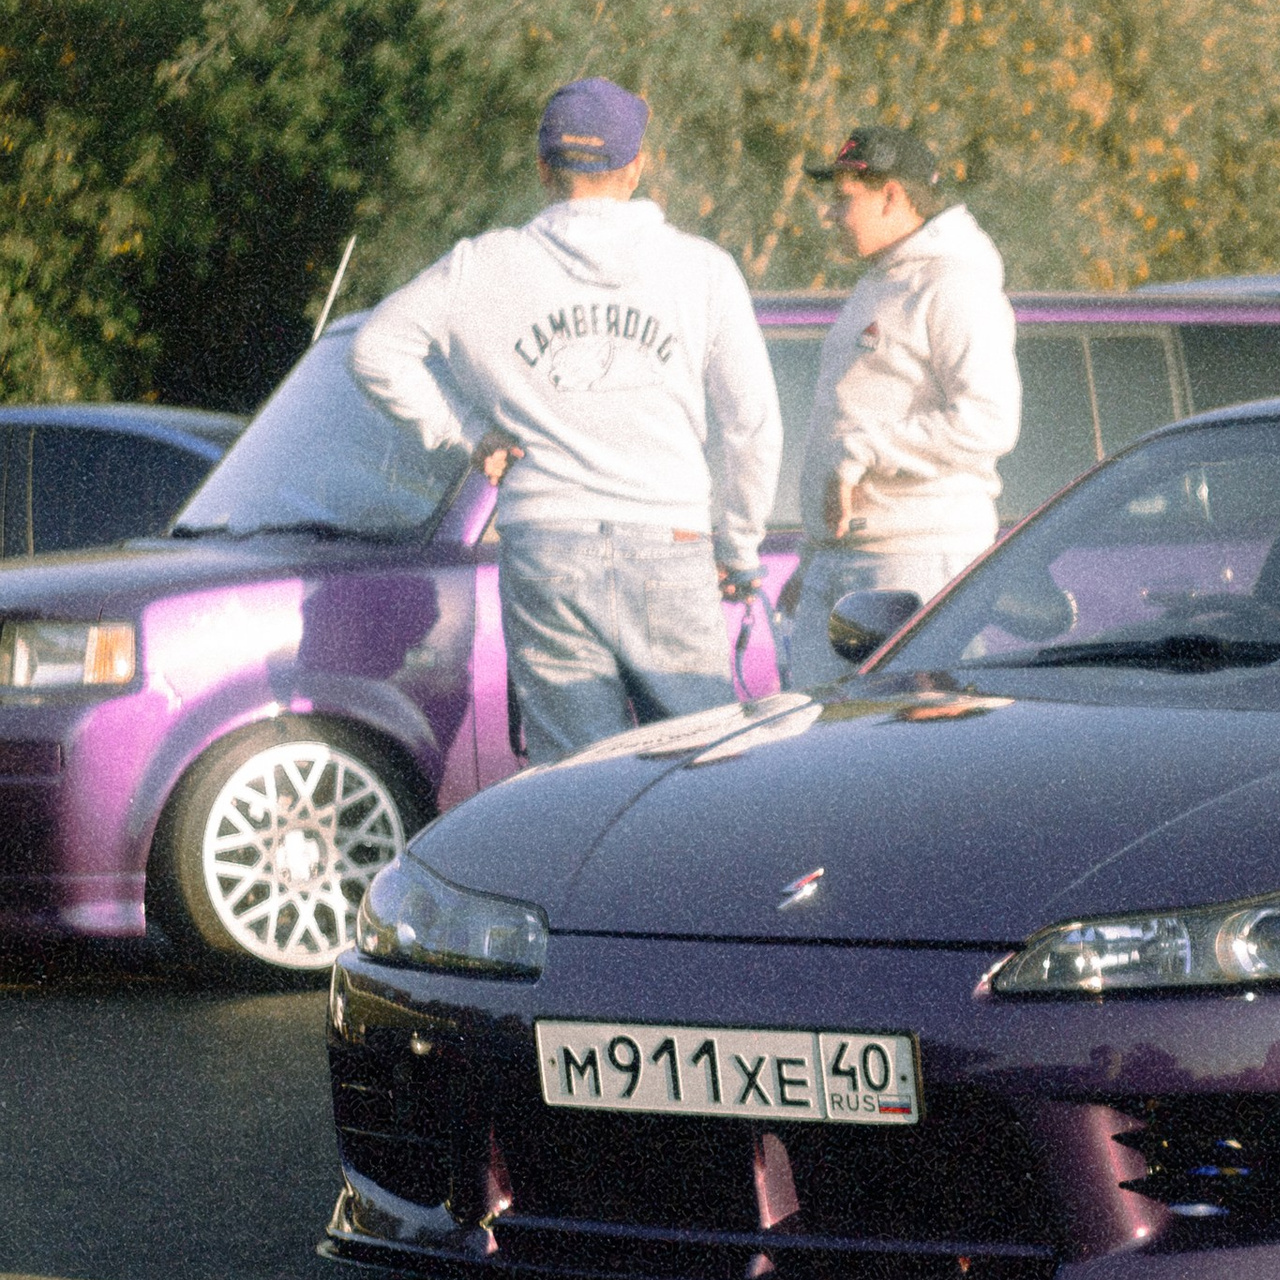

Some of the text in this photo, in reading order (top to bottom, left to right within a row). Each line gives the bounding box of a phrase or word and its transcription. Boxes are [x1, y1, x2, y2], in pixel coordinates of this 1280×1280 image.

[514, 303, 678, 368] CAMBERDOG
[831, 1042, 889, 1092] 40
[830, 1093, 876, 1113] RUS
